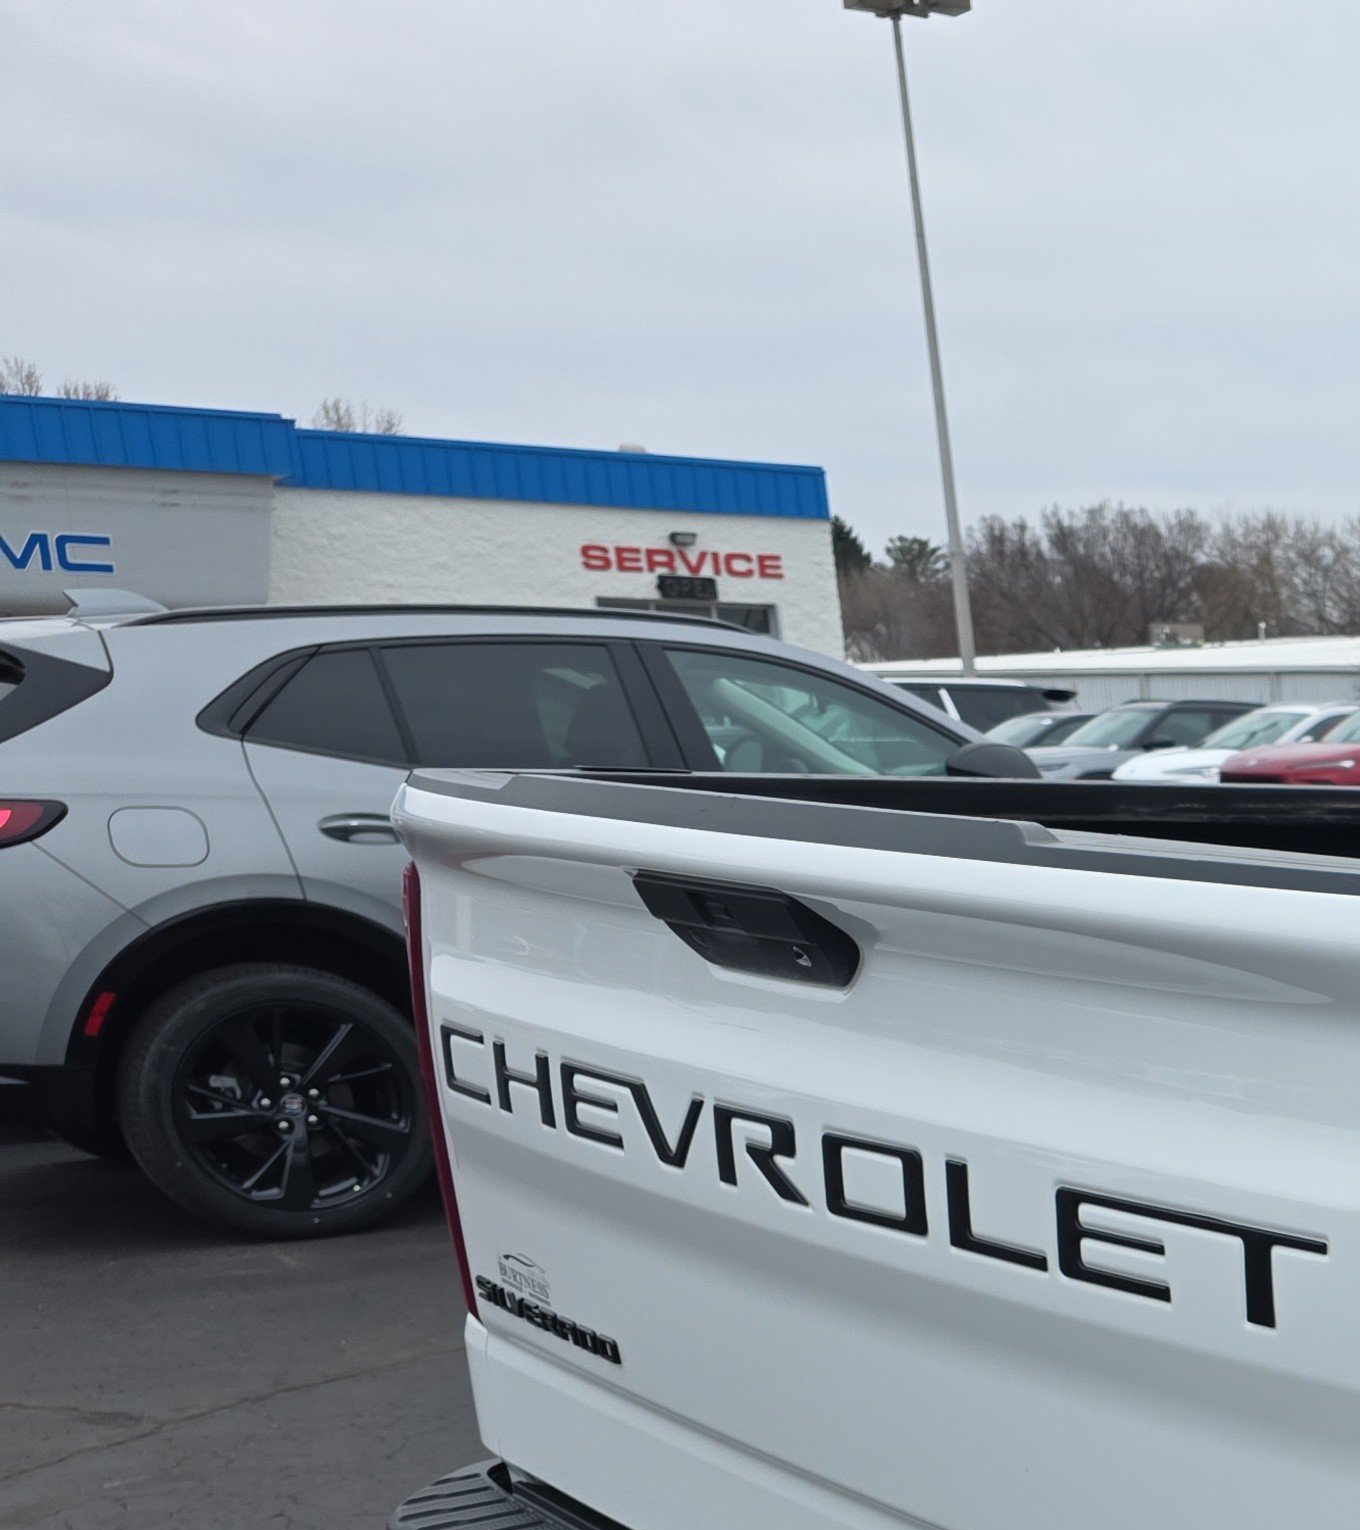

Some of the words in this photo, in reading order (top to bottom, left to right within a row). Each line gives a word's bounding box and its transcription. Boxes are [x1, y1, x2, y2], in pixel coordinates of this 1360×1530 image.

[0, 533, 114, 573] MC
[580, 544, 785, 581] SERVICE
[439, 1022, 1329, 1329] CHEVROLET
[474, 1274, 622, 1365] SILVERADO
